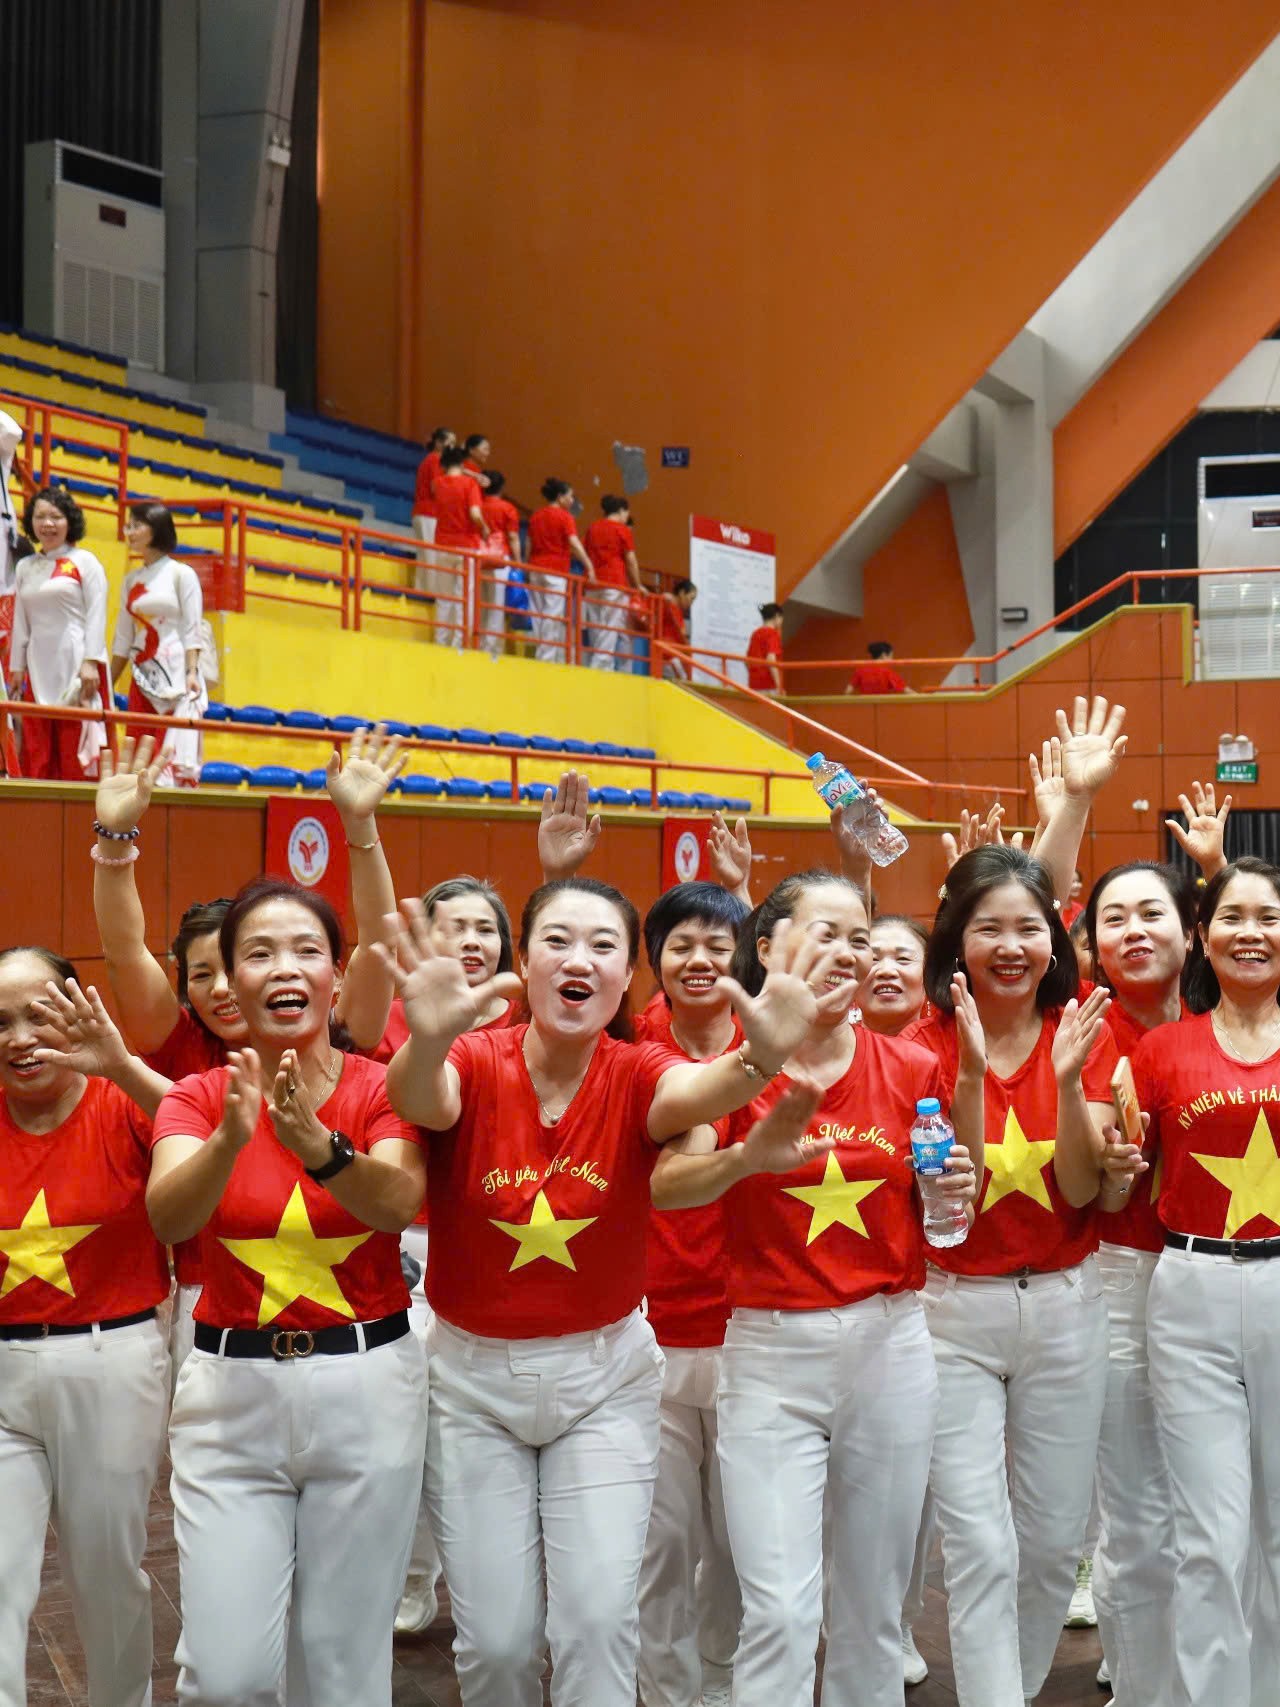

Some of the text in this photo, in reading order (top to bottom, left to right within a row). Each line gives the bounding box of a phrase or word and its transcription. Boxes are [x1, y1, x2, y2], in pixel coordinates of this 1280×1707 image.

[1177, 1105, 1193, 1130] KỶ
[1190, 1090, 1226, 1117] NIỆM
[858, 1125, 896, 1157] Nam
[481, 1167, 511, 1195] Tôi
[514, 1164, 539, 1188] yêu
[570, 1160, 609, 1192] Nam
